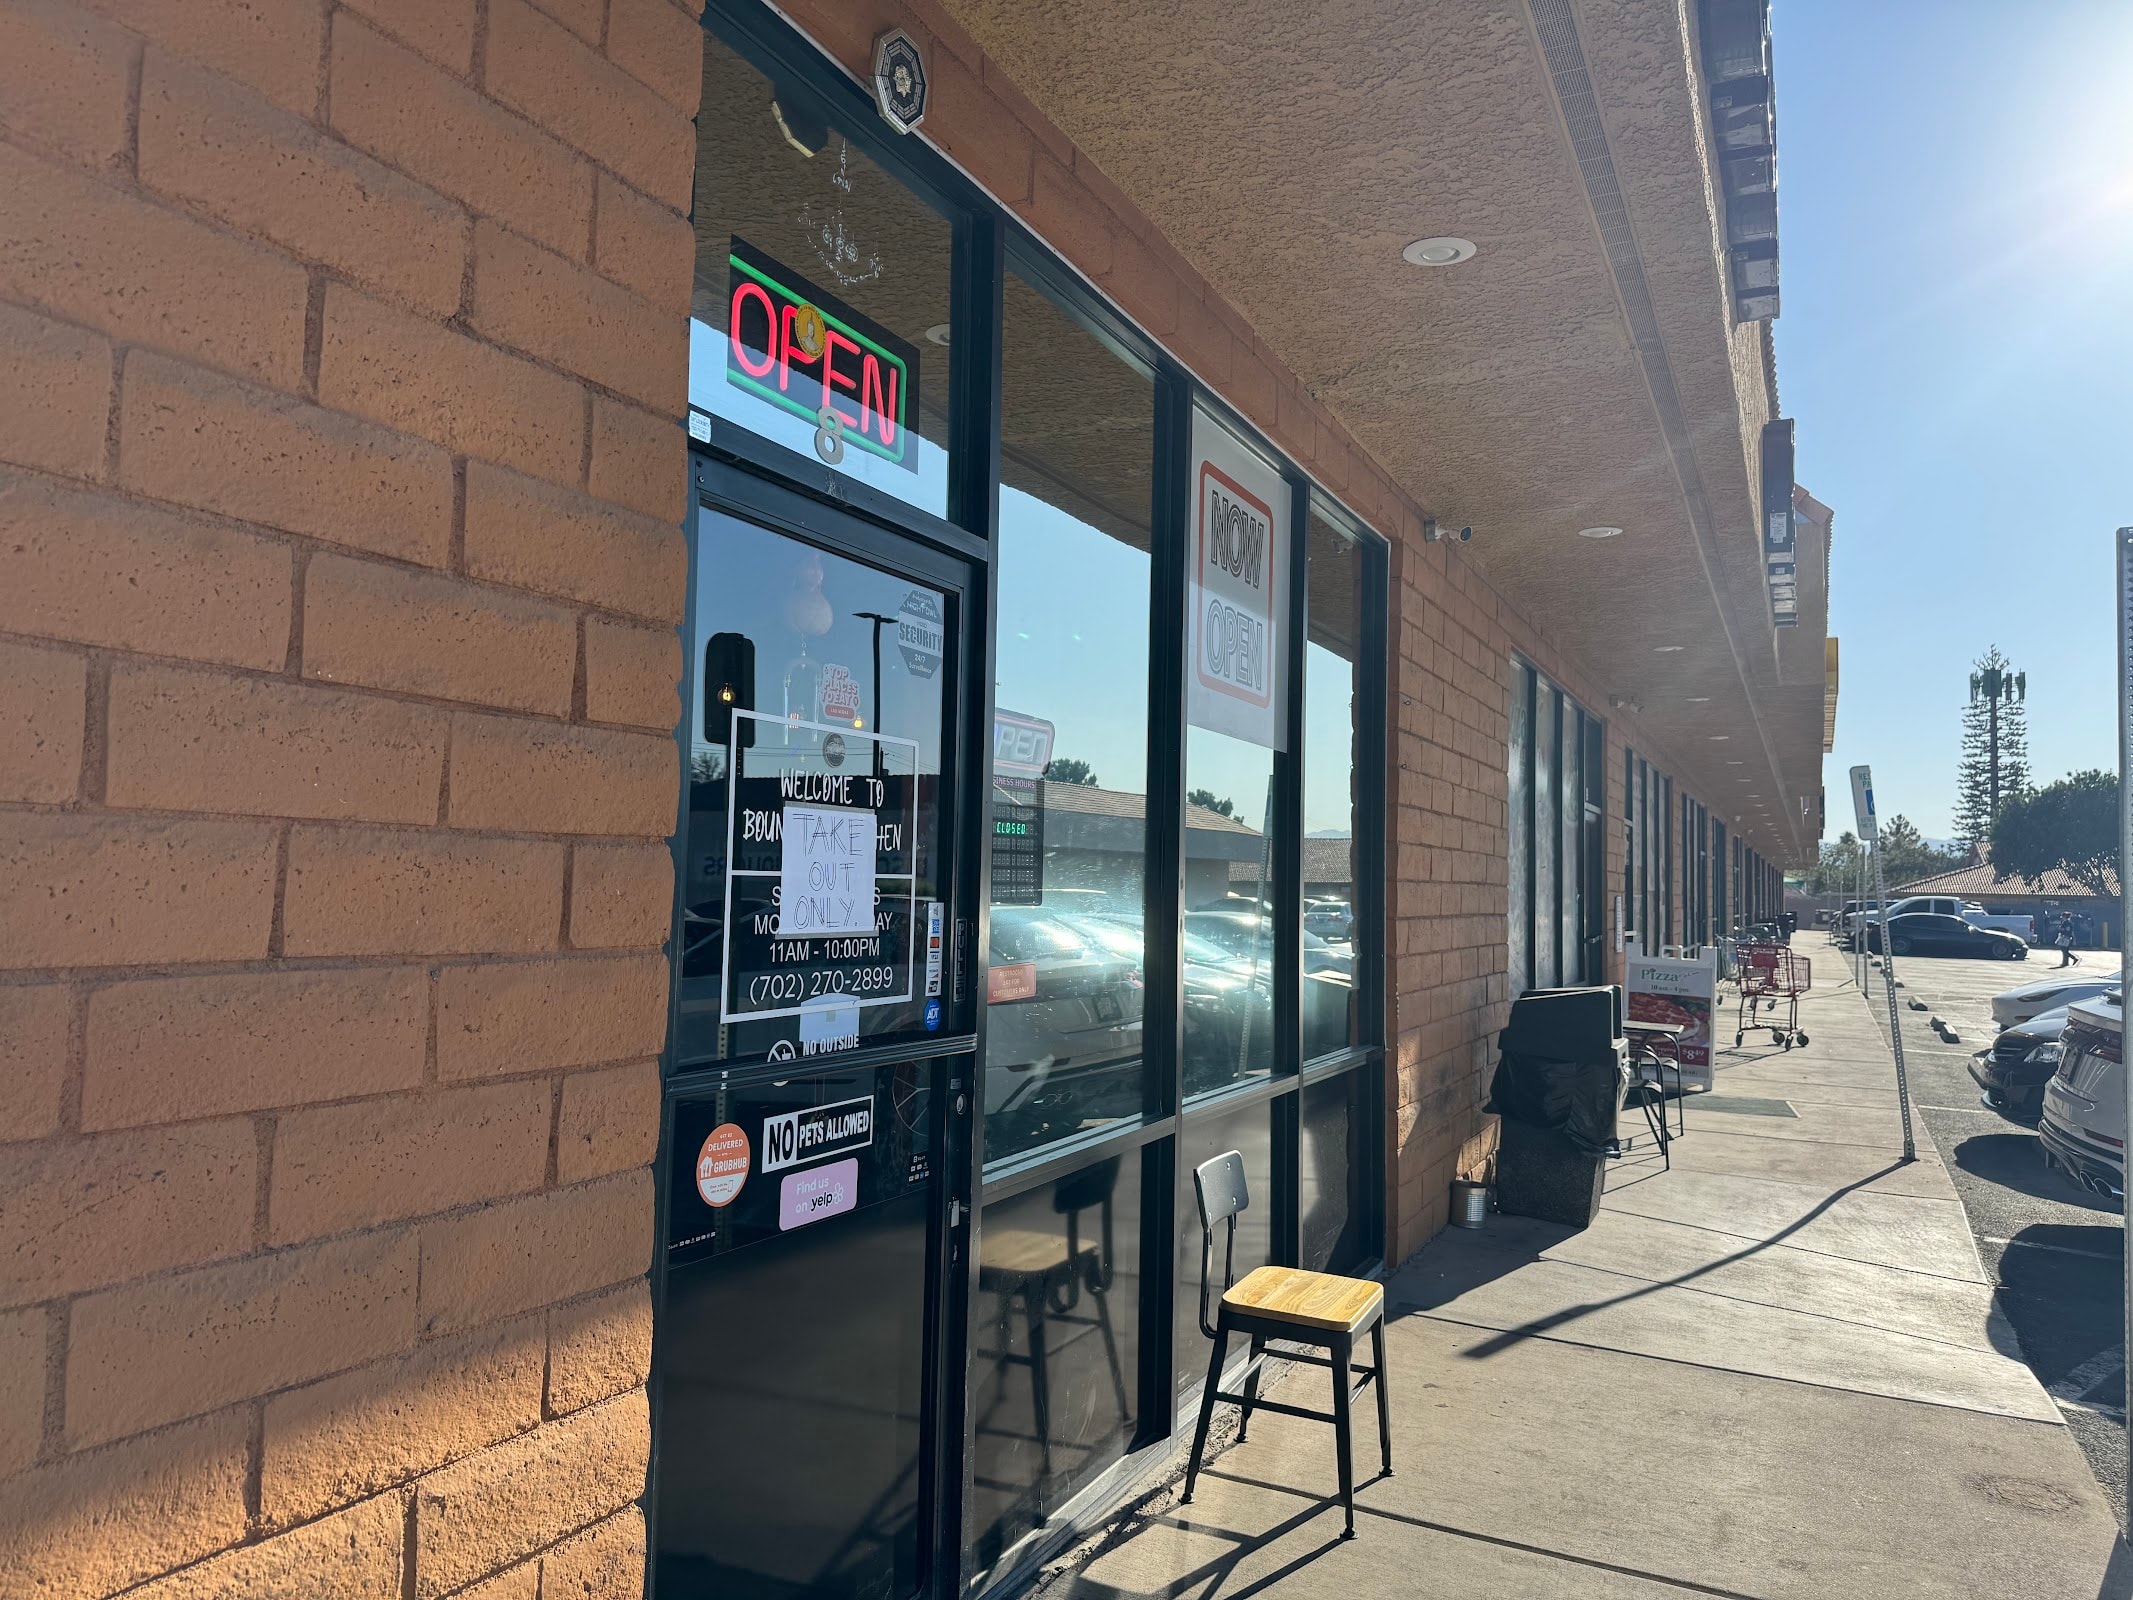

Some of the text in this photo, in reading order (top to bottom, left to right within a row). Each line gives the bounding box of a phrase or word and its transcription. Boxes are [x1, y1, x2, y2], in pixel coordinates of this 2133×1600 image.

[730, 282, 897, 446] OPEN
[814, 406, 844, 465] 8
[1210, 489, 1264, 590] NOW
[899, 622, 942, 652] SECURITY
[1206, 598, 1263, 691] OPEN
[824, 679, 858, 696] PLACES
[831, 667, 849, 681] TOP
[780, 768, 884, 808] WELCOME TO
[743, 808, 783, 842] BOUN
[792, 813, 864, 857] TAKE
[996, 822, 1026, 835] CLOSED
[809, 861, 855, 892] OUT
[794, 895, 858, 930] ONLY.
[769, 941, 809, 962] 11AM
[823, 938, 880, 959] 10:00PM
[957, 922, 965, 975] PULL
[749, 966, 893, 1005] (702) 270-2899
[1641, 968, 1679, 982] Pizza
[927, 1008, 939, 1020] ADT
[803, 1034, 860, 1057] NO OUTSIDE
[708, 1139, 744, 1152] DELIVERED
[768, 1110, 870, 1164] NO PETS ALLOWED
[713, 1157, 747, 1174] GRUBHUB
[796, 1178, 829, 1195] Find us
[795, 1192, 833, 1213] on yelp
